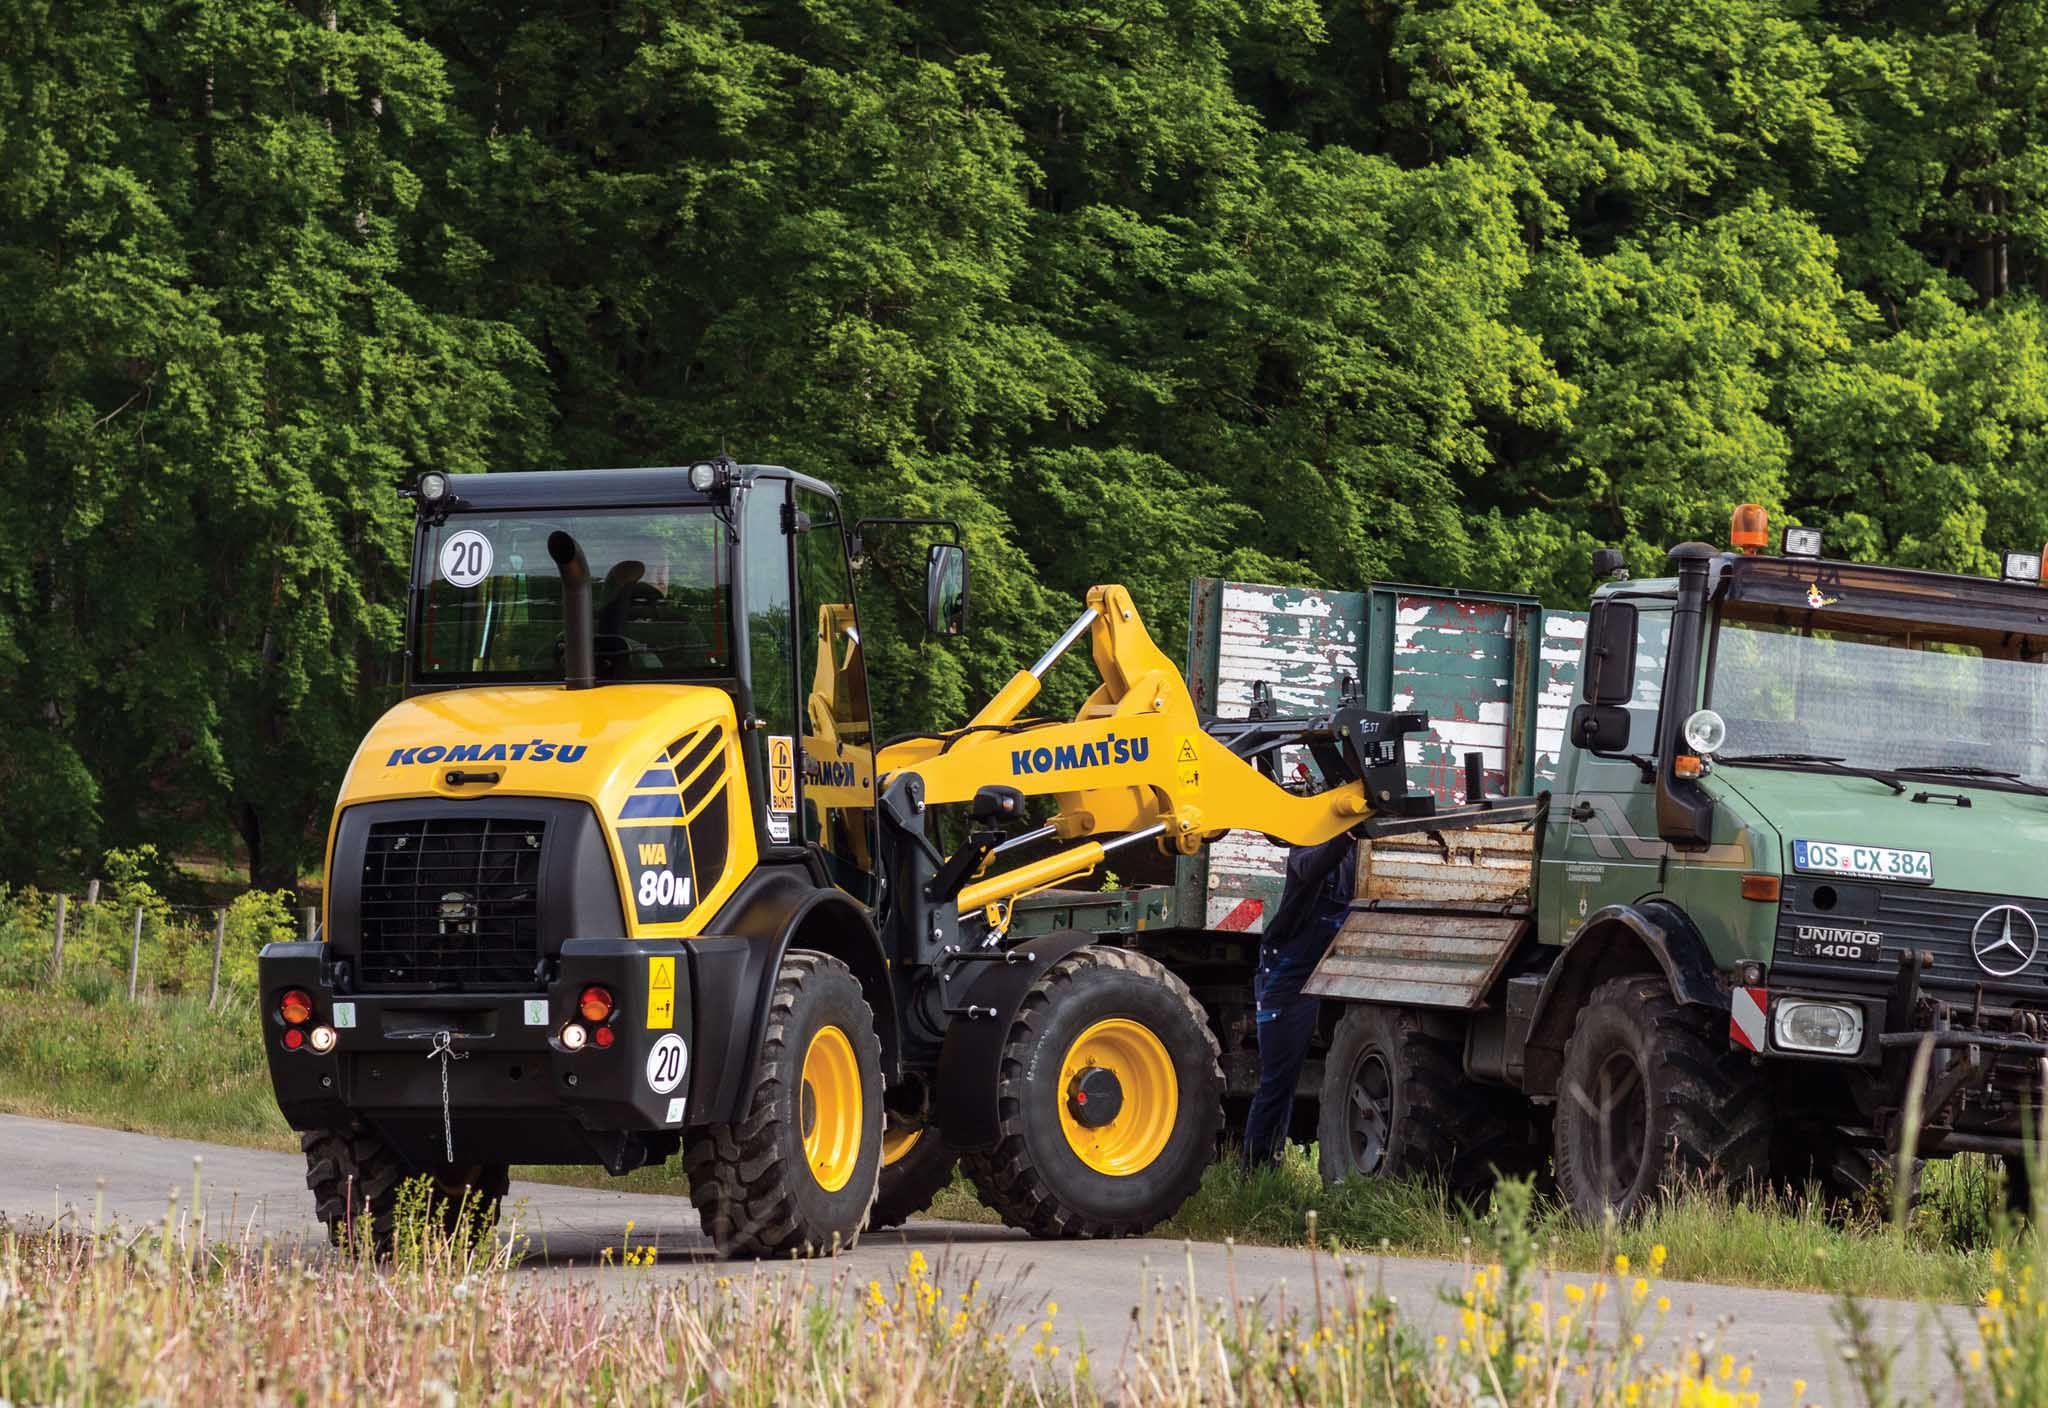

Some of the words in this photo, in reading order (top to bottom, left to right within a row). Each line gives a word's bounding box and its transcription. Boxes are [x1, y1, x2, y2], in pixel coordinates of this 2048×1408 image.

[451, 541, 483, 576] 20
[386, 739, 588, 767] KOMATSU
[1011, 733, 1149, 776] KOMATSU
[773, 795, 794, 809] BUNTE
[638, 843, 668, 866] WA
[1810, 845, 1838, 867] OS
[1854, 849, 1882, 871] CX
[1888, 852, 1928, 876] 384
[638, 870, 691, 906] 80M
[1798, 927, 1880, 946] UNIMOG
[1814, 943, 1862, 959] 1400
[654, 1045, 681, 1082] 20
